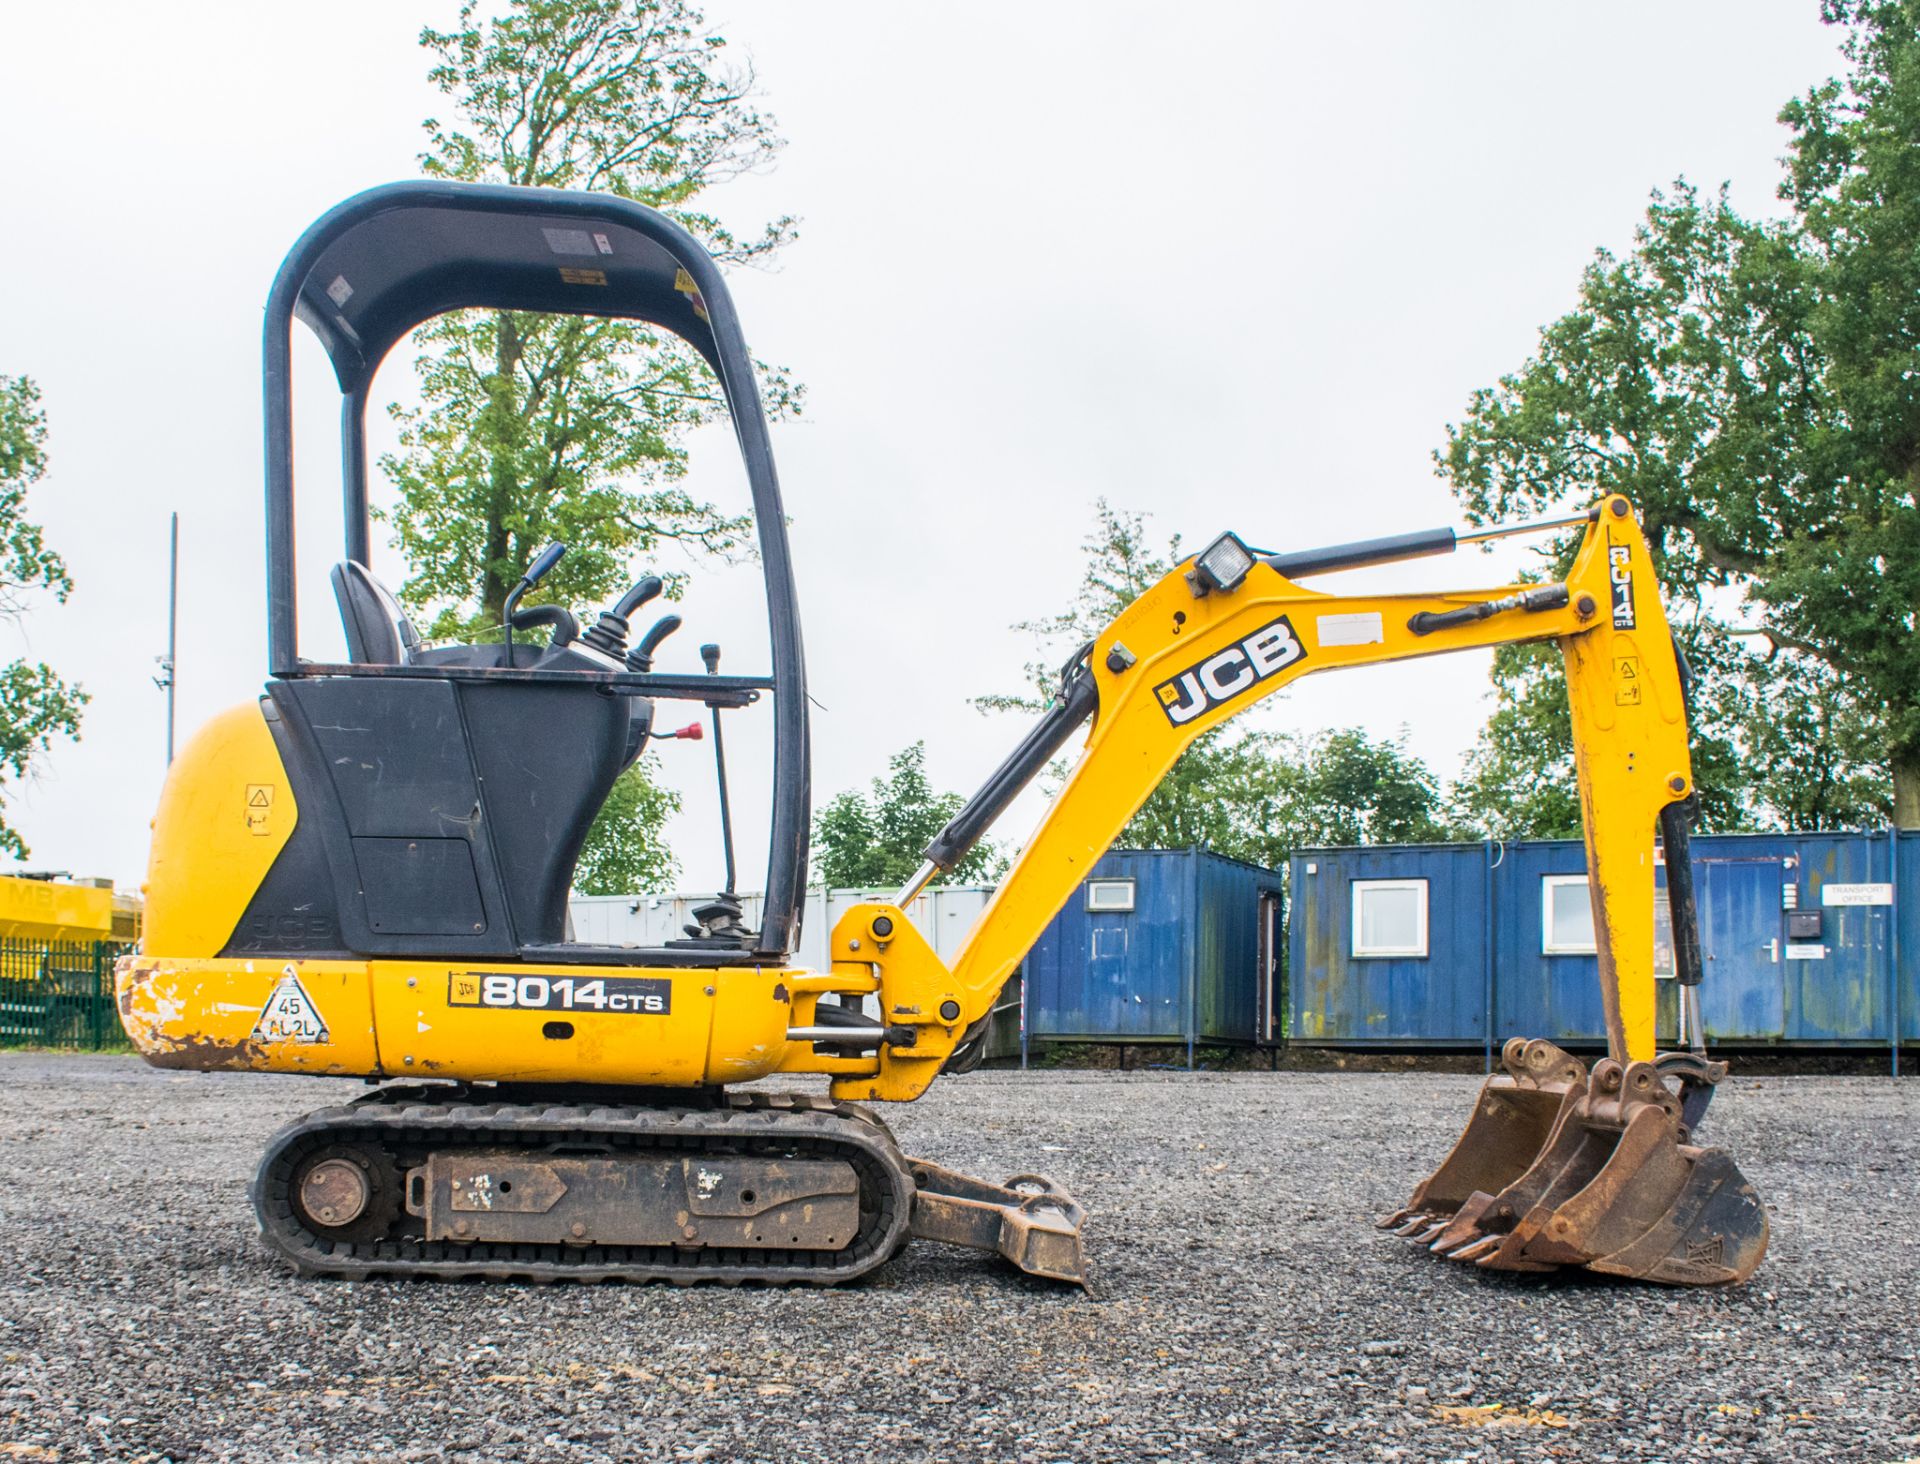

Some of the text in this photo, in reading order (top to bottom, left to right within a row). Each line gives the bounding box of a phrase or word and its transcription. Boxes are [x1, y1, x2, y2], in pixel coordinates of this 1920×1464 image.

[1167, 623, 1301, 723] JCB
[1841, 895, 1873, 903] OFFICE
[253, 915, 333, 939] JCB
[279, 998, 300, 1015] 45
